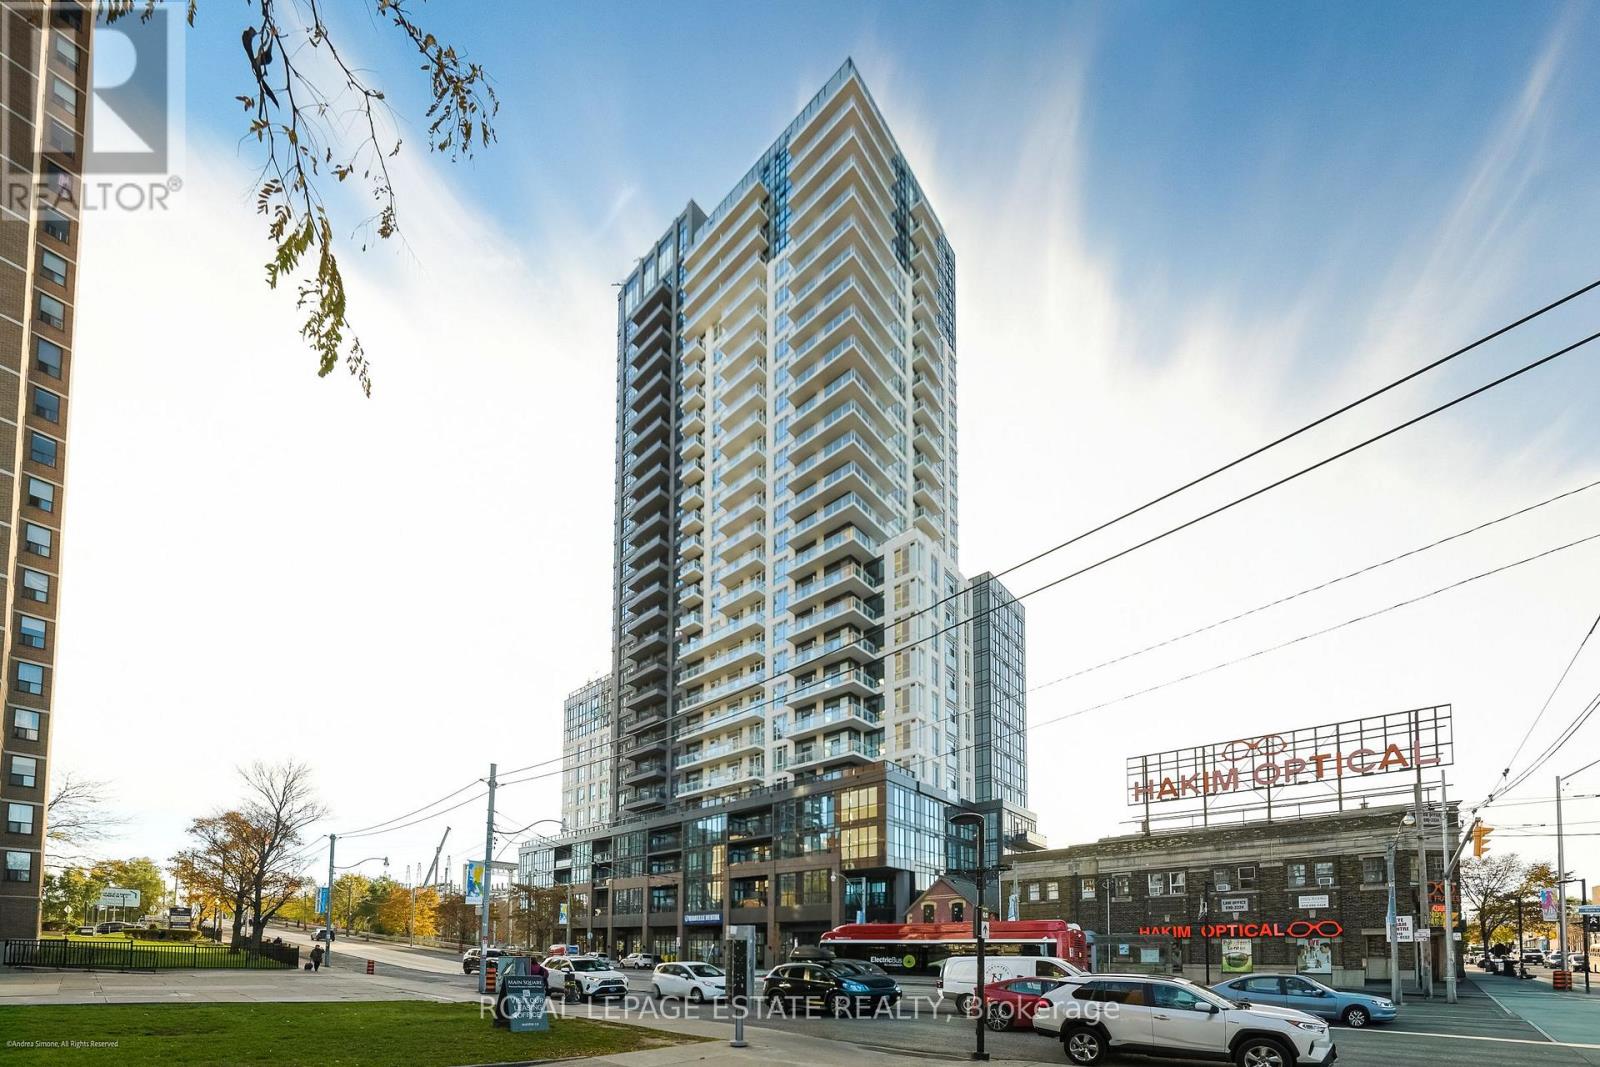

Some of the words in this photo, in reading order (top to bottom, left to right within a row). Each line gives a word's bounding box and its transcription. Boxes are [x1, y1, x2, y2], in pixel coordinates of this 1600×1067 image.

[1133, 767, 1239, 802] HAKIM
[1253, 740, 1441, 786] OPTICAL
[1139, 926, 1191, 938] HAKIM
[1201, 923, 1286, 938] OPTICAL
